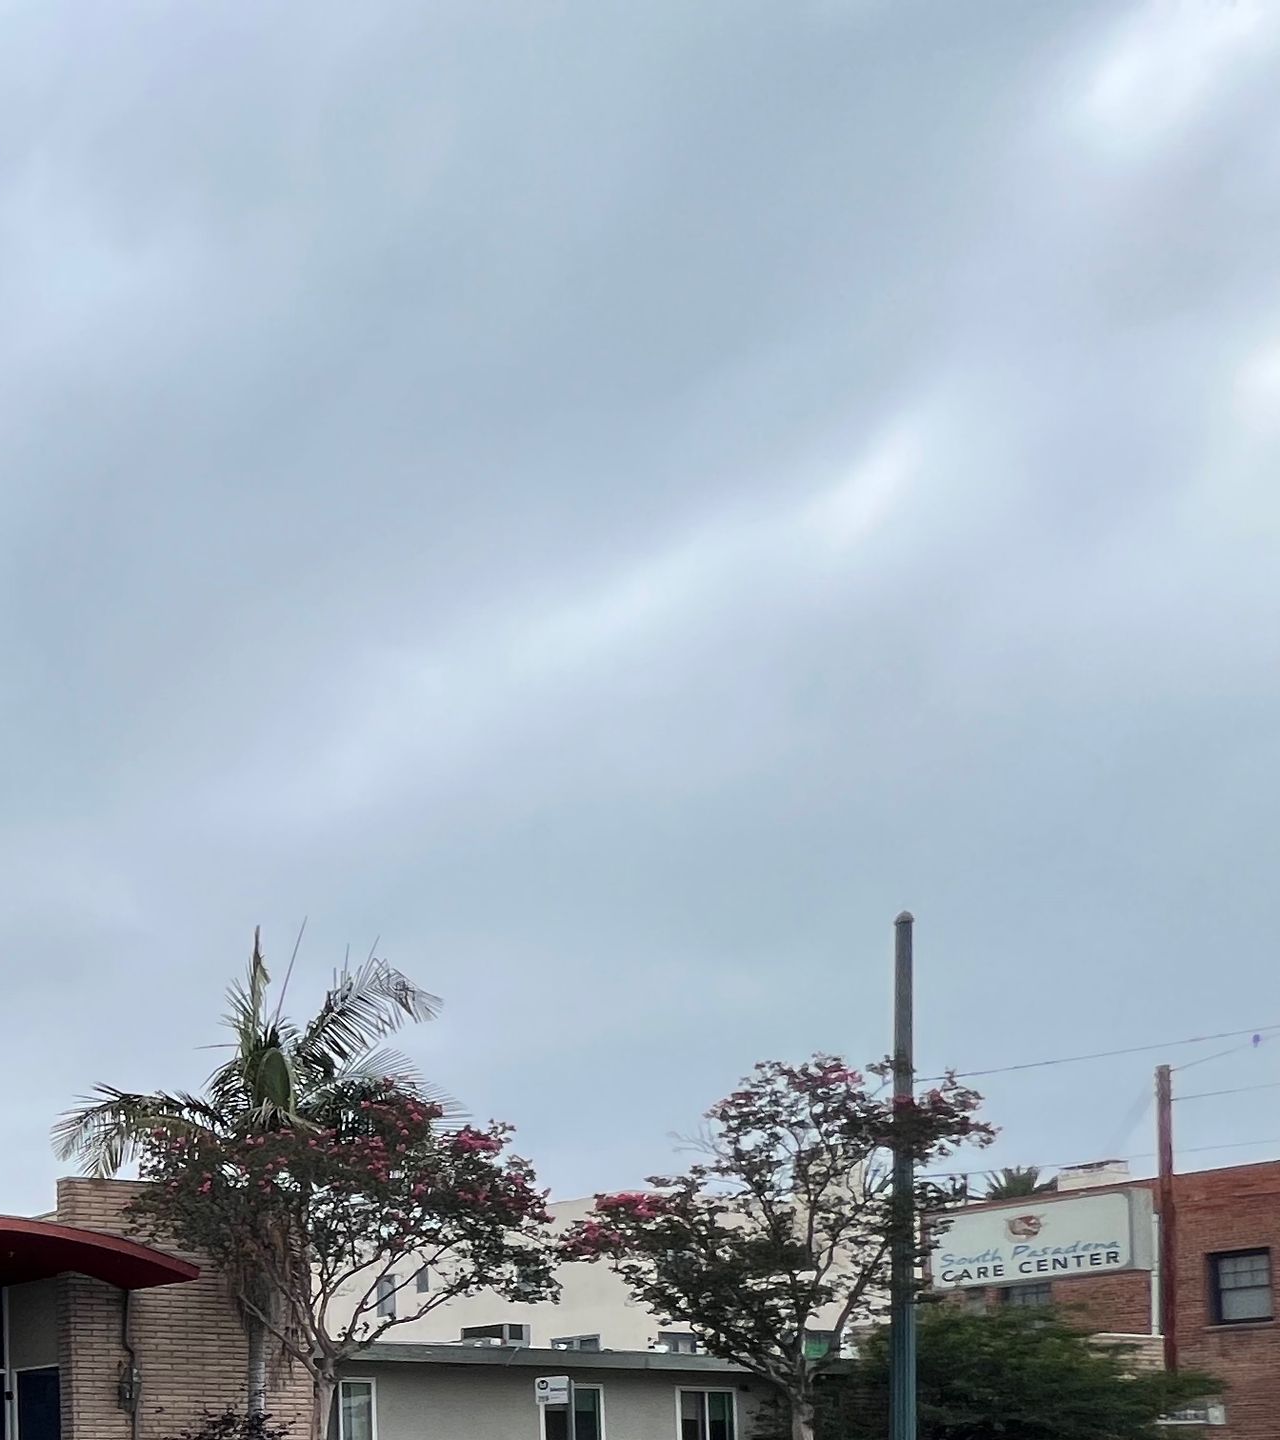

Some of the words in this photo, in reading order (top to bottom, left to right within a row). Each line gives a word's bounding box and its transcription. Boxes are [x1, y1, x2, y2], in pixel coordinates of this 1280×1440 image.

[940, 1248, 1002, 1268] South
[1011, 1239, 1121, 1261] Pasadena
[941, 1264, 1004, 1283] CARE
[1019, 1251, 1120, 1274] CENTER
